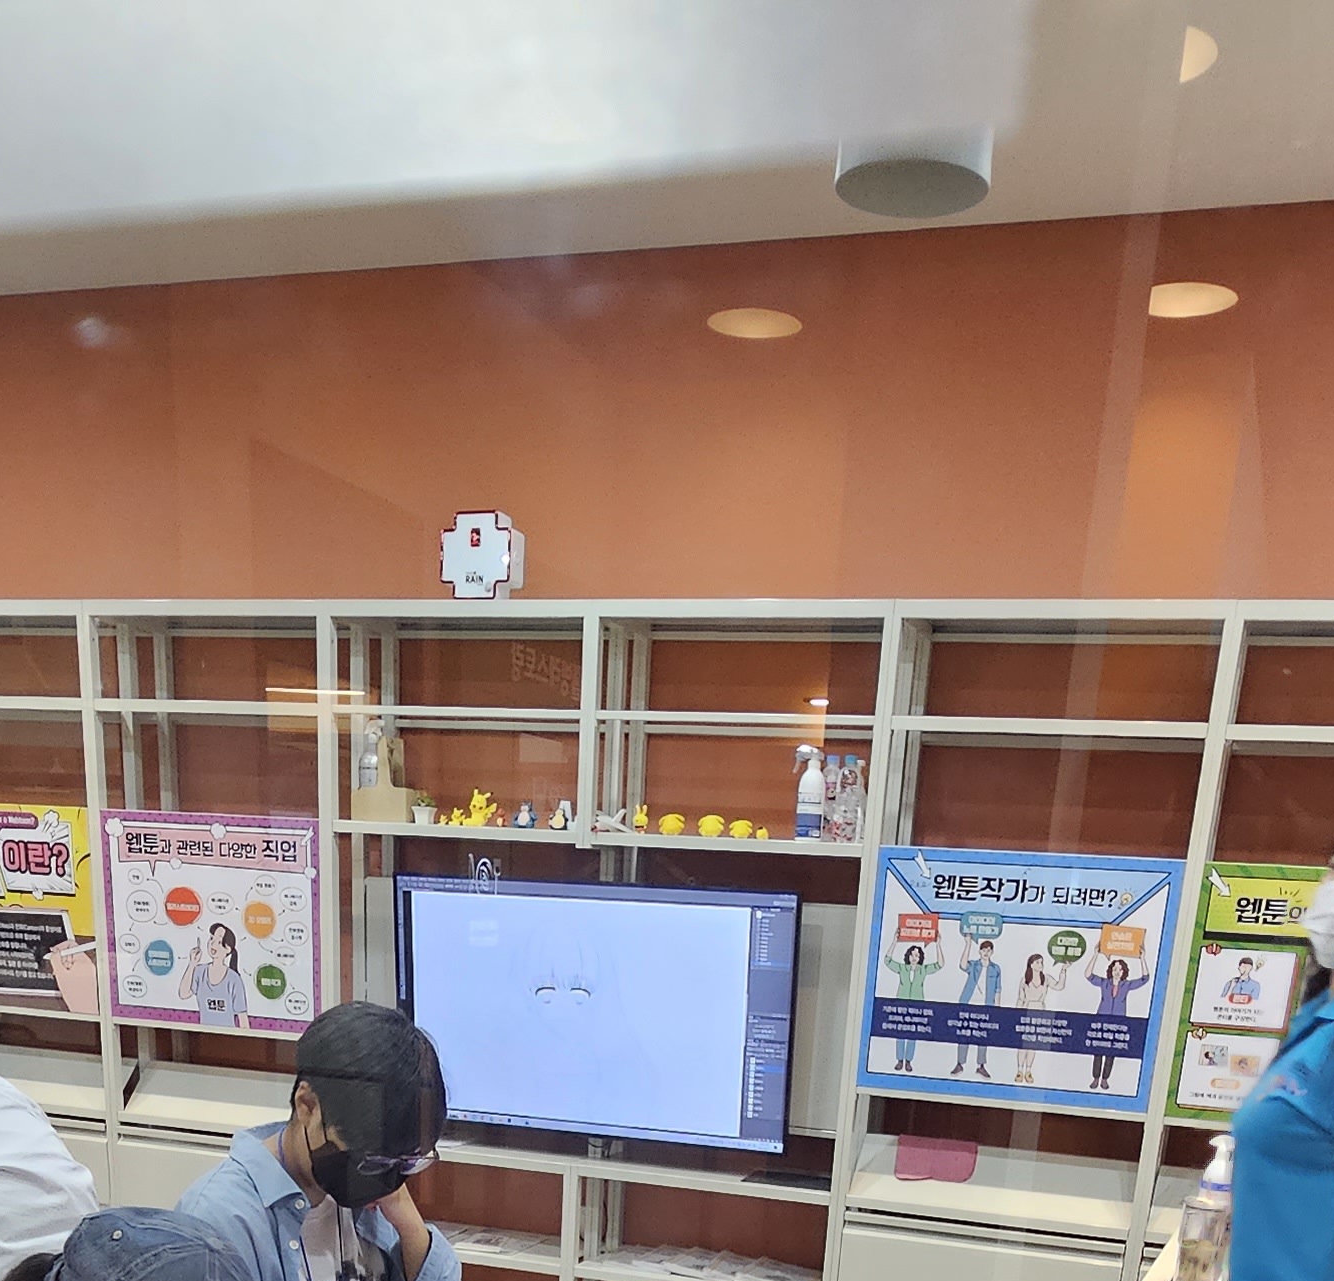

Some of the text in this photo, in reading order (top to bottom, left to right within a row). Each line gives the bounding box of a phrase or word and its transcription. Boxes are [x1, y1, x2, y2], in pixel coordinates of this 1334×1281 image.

[465, 575, 484, 584] RAIN
[2, 841, 70, 877] 이란?
[125, 831, 298, 862] 웹툰과 관련된 다양한 직업
[932, 873, 1118, 909] 웹툰작가가 되려면?
[207, 998, 226, 1012] 웹툰
